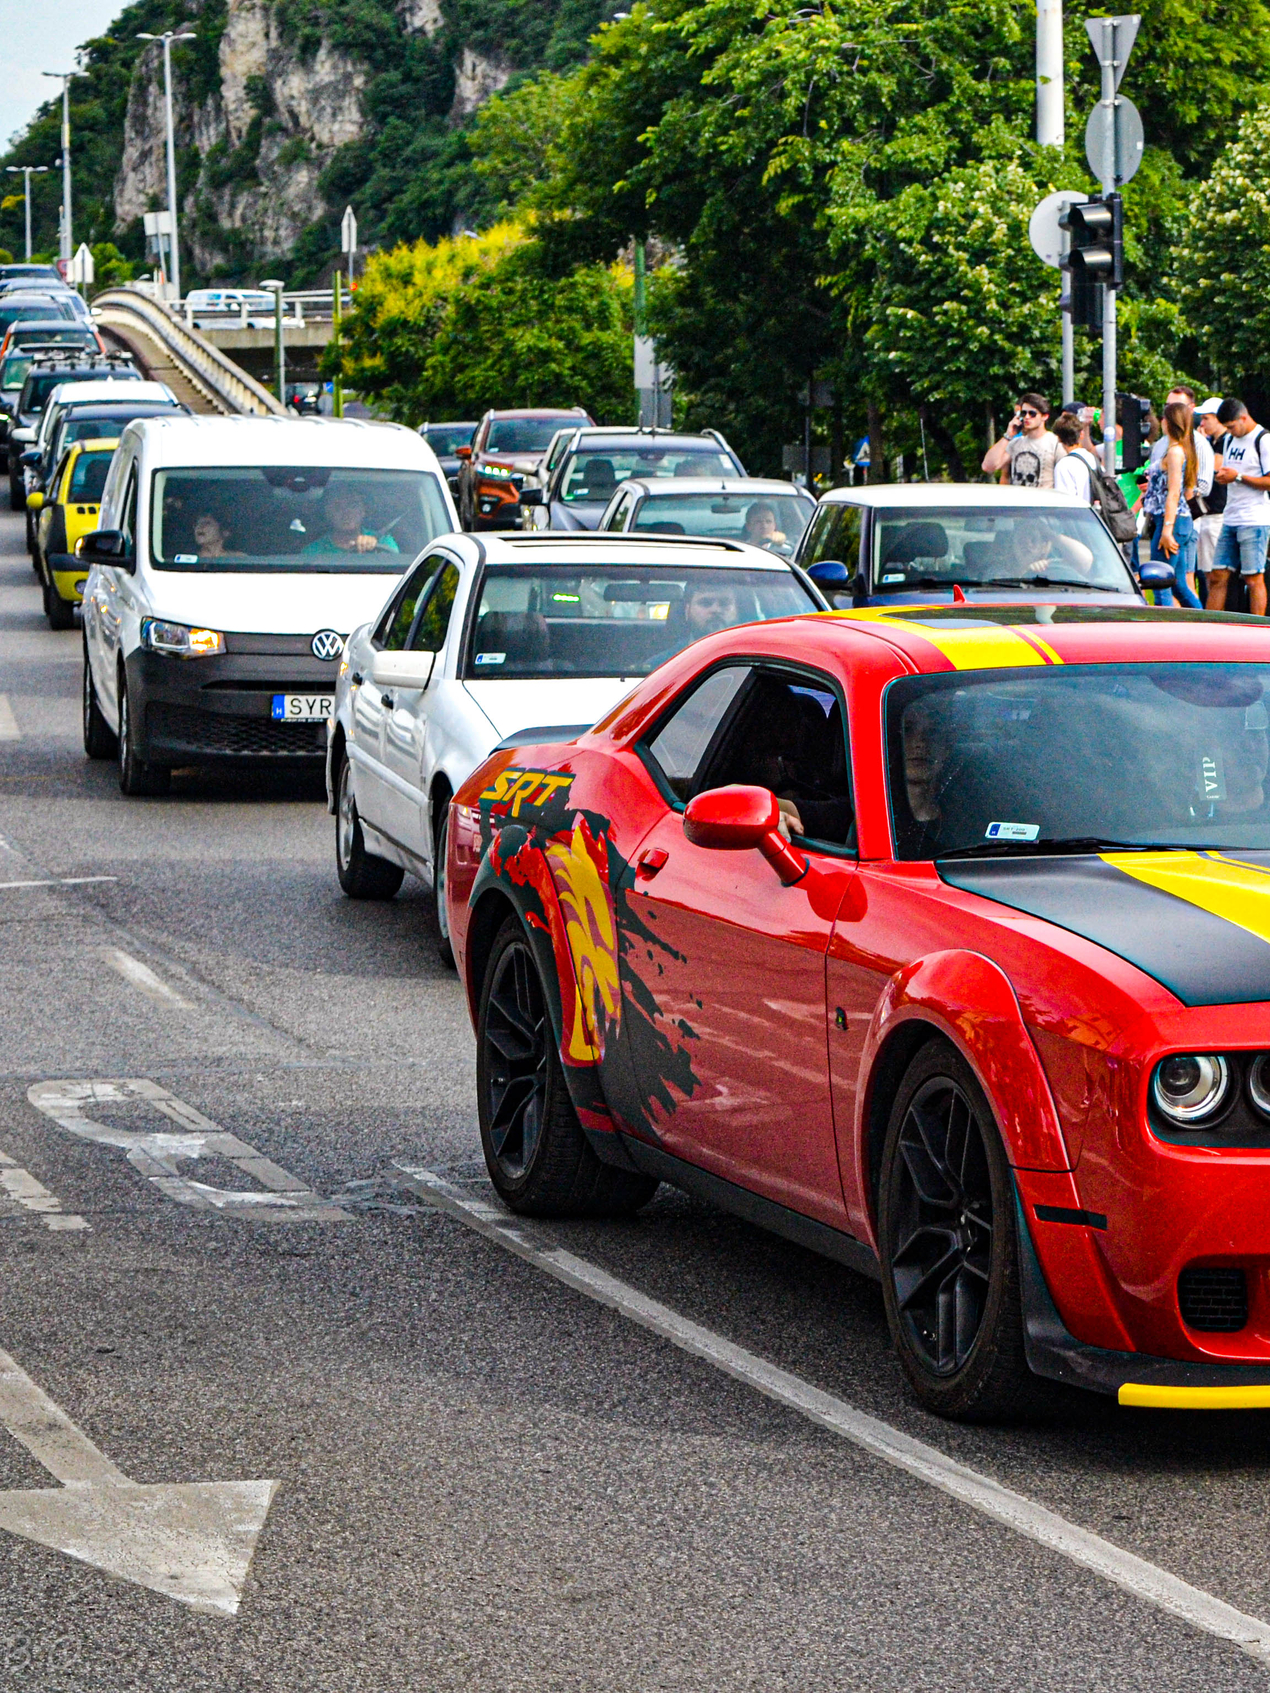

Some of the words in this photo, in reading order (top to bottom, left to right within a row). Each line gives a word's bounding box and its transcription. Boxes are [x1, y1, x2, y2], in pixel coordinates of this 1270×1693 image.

[1229, 448, 1246, 460] HH
[1202, 757, 1218, 792] VIP
[480, 771, 574, 818] SRT
